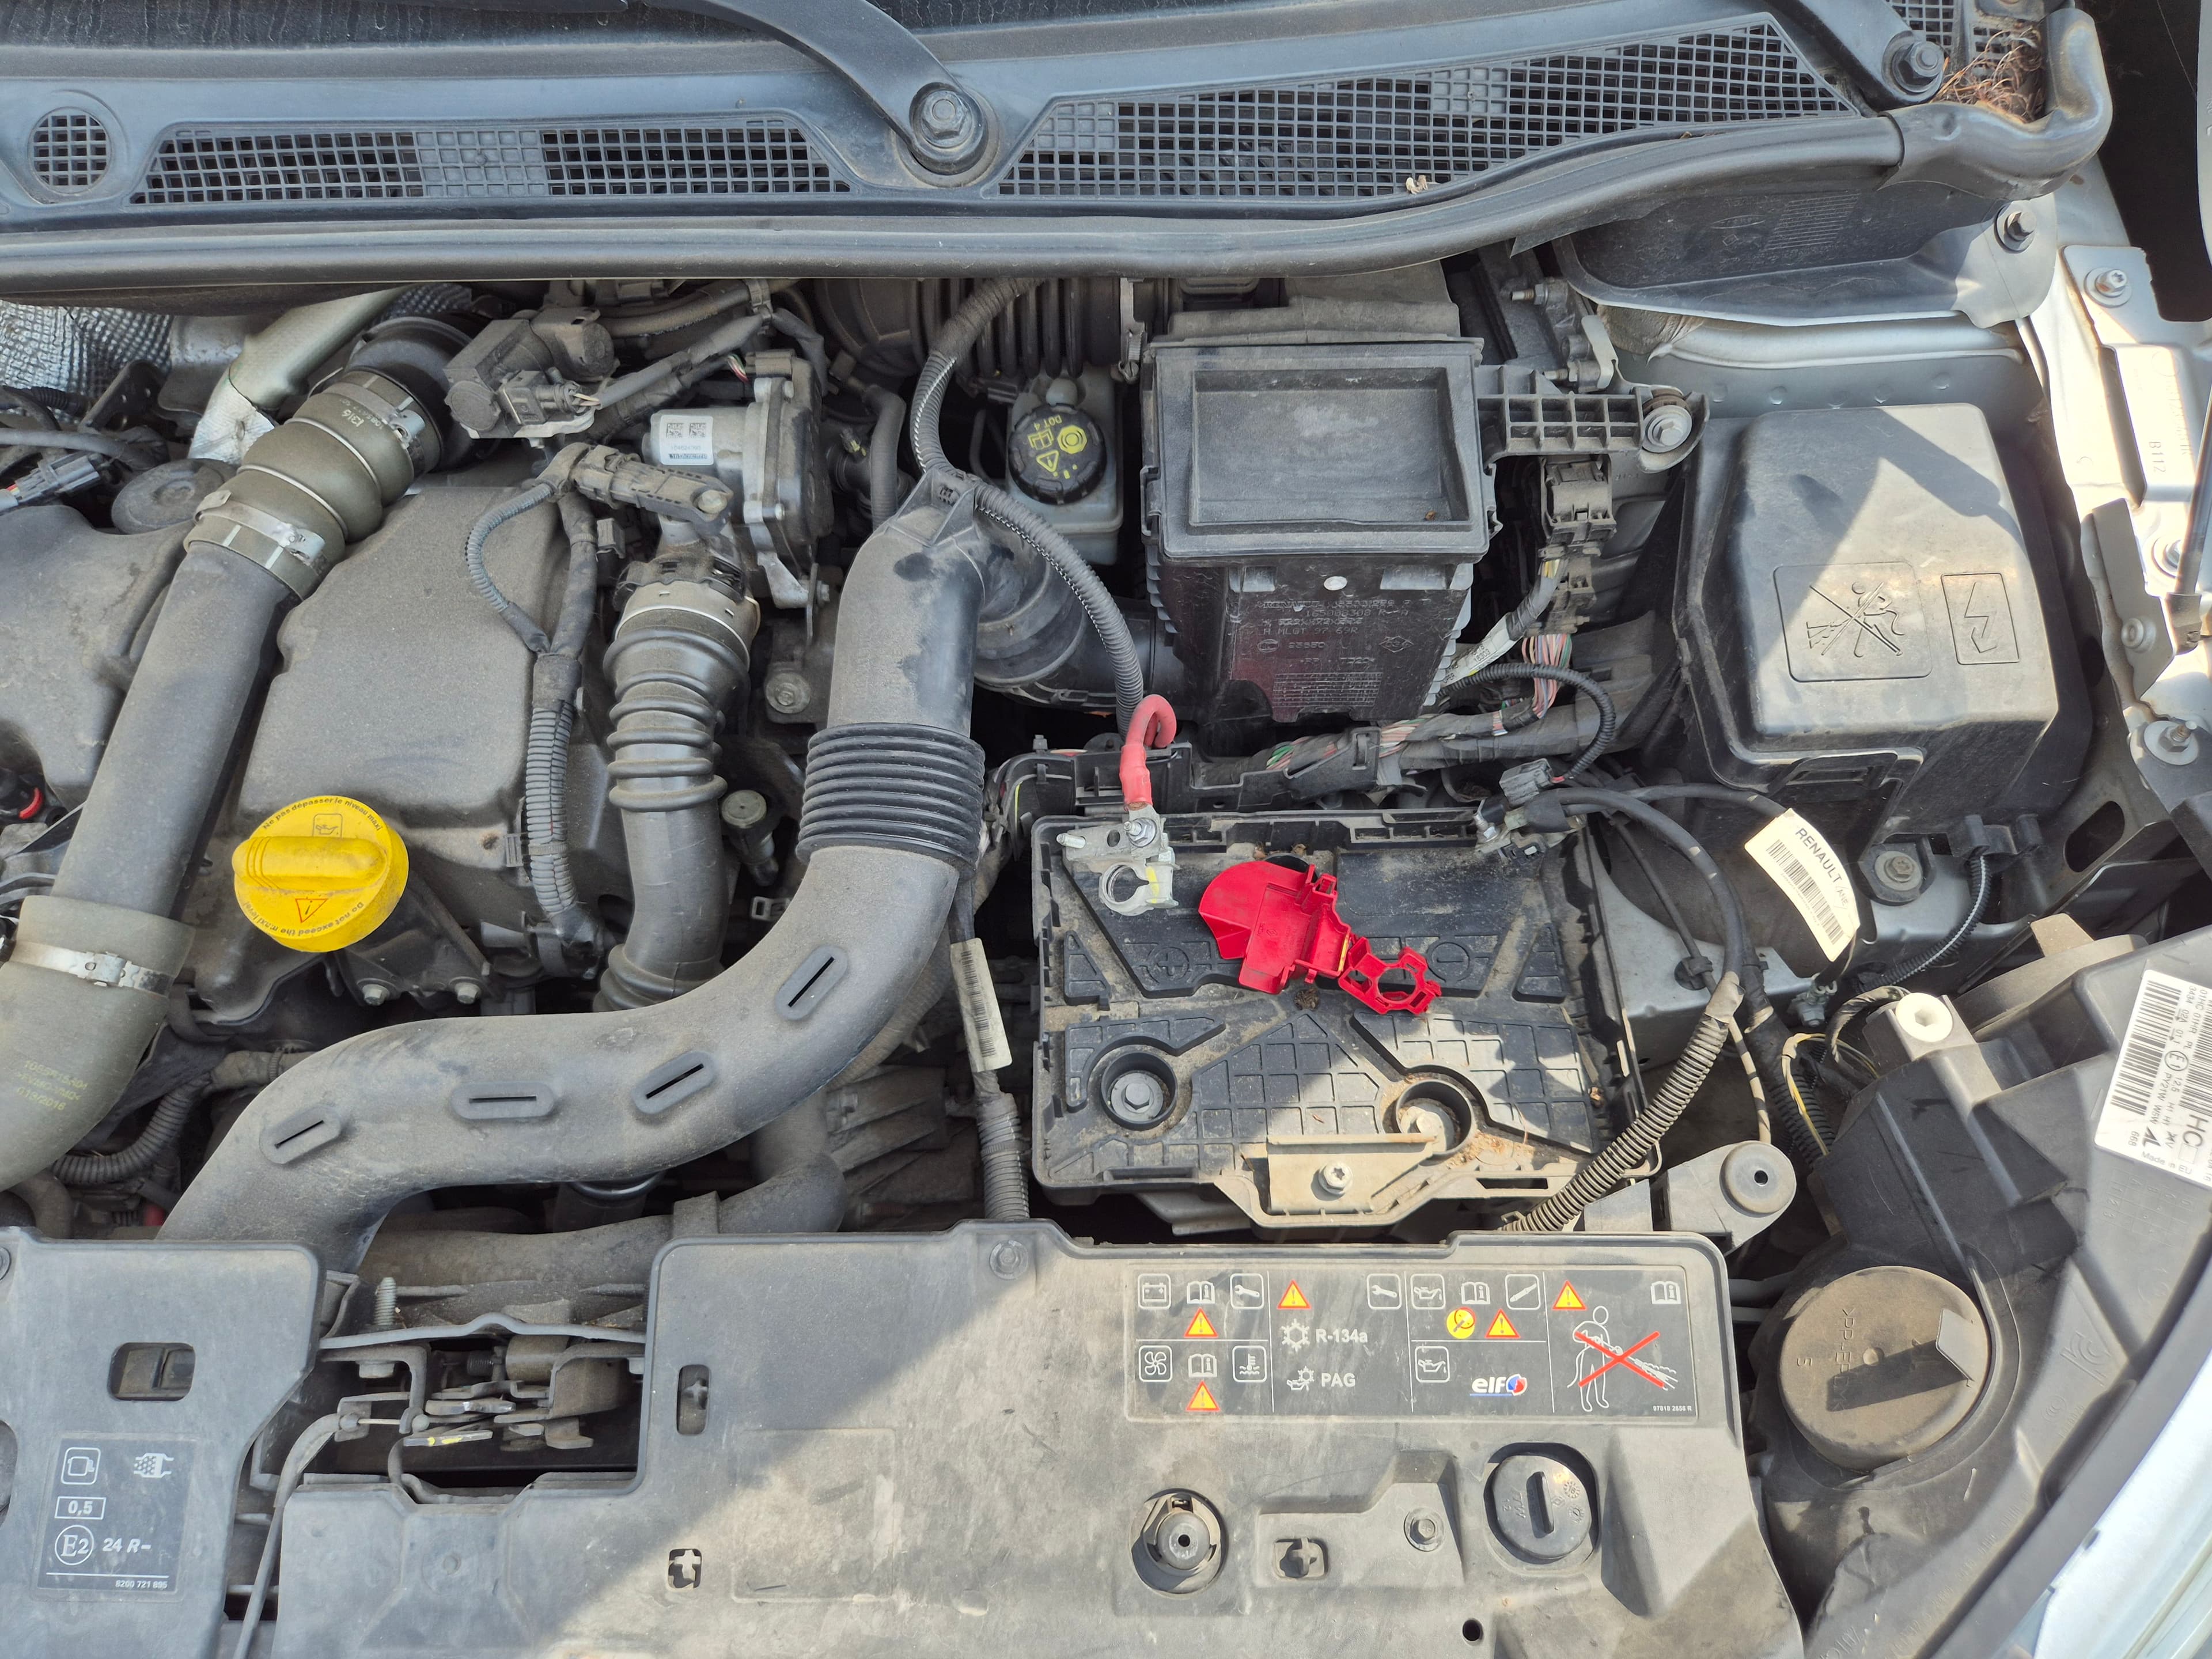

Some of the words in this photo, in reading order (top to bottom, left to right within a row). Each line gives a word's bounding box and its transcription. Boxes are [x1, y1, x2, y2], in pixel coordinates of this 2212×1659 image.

[1033, 422, 1040, 431] 4
[1043, 415, 1062, 428] DOT
[2149, 441, 2166, 473] B112
[263, 819, 275, 830] Ne
[276, 809, 291, 821] pas
[291, 798, 334, 811] dépasser
[344, 800, 368, 816] niveau
[368, 814, 382, 831] maxi
[1795, 828, 1842, 883] RENAULT
[351, 902, 364, 913] Do
[335, 912, 351, 925] not
[281, 926, 296, 936] the
[298, 922, 334, 936] exceed
[2156, 1071, 2172, 1101] PY21W
[2149, 1103, 2162, 1124] W5W
[2180, 1113, 2210, 1149] HC
[2141, 1151, 2166, 1166] Made
[2178, 1165, 2192, 1175] EU
[1316, 1328, 1368, 1343] R-134a
[1321, 1373, 1355, 1387] PAG
[1472, 1377, 1506, 1393] elf
[68, 1500, 93, 1516] 0,5
[60, 1534, 89, 1557] E2
[102, 1538, 123, 1552] 24
[115, 1580, 134, 1588] 8200
